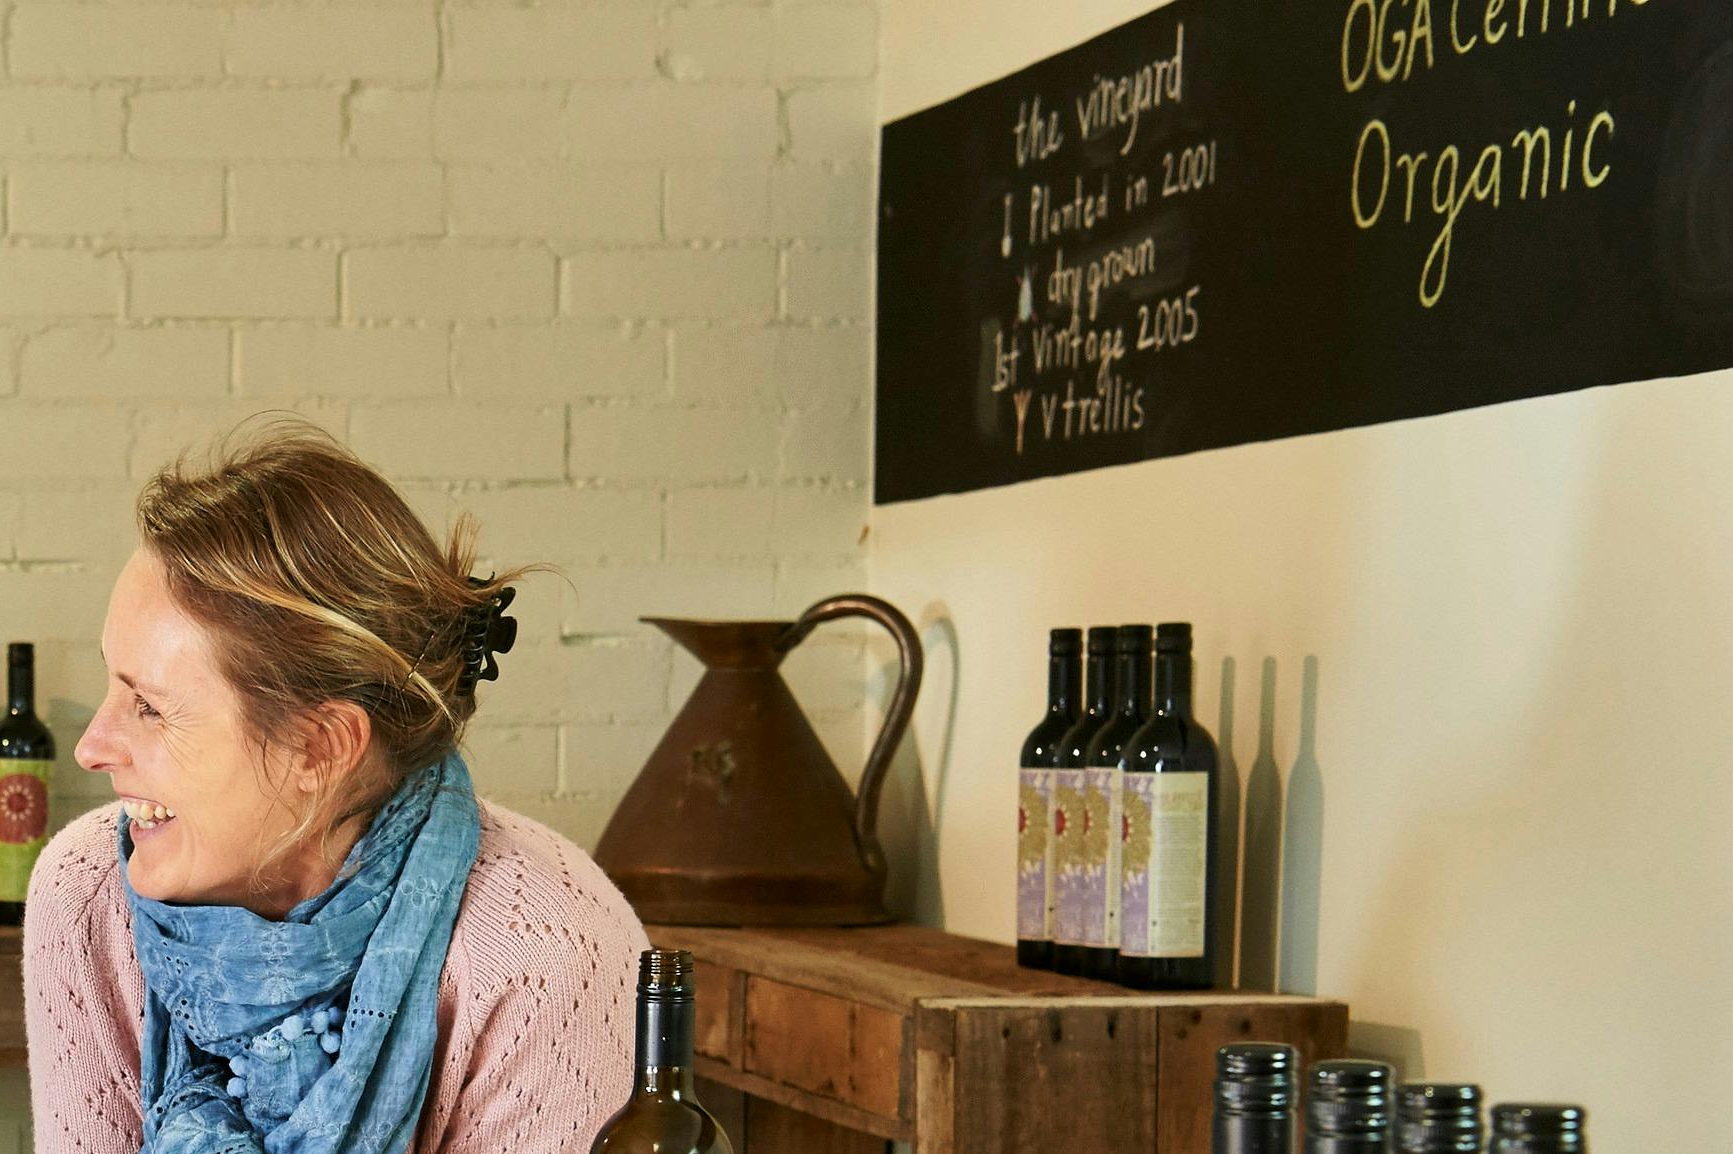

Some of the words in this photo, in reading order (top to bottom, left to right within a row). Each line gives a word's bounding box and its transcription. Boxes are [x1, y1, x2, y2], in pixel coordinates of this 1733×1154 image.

[1013, 95, 1064, 168] the
[1075, 22, 1184, 157] vineyard
[1342, 0, 1434, 92] OGA
[1030, 175, 1109, 246] Planted
[1125, 175, 1149, 212] in
[1162, 139, 1218, 198] 2001
[1352, 100, 1615, 308] Organic
[1032, 312, 1125, 397] Vintage
[1137, 285, 1201, 351] 2005
[1063, 377, 1145, 442] trellis
